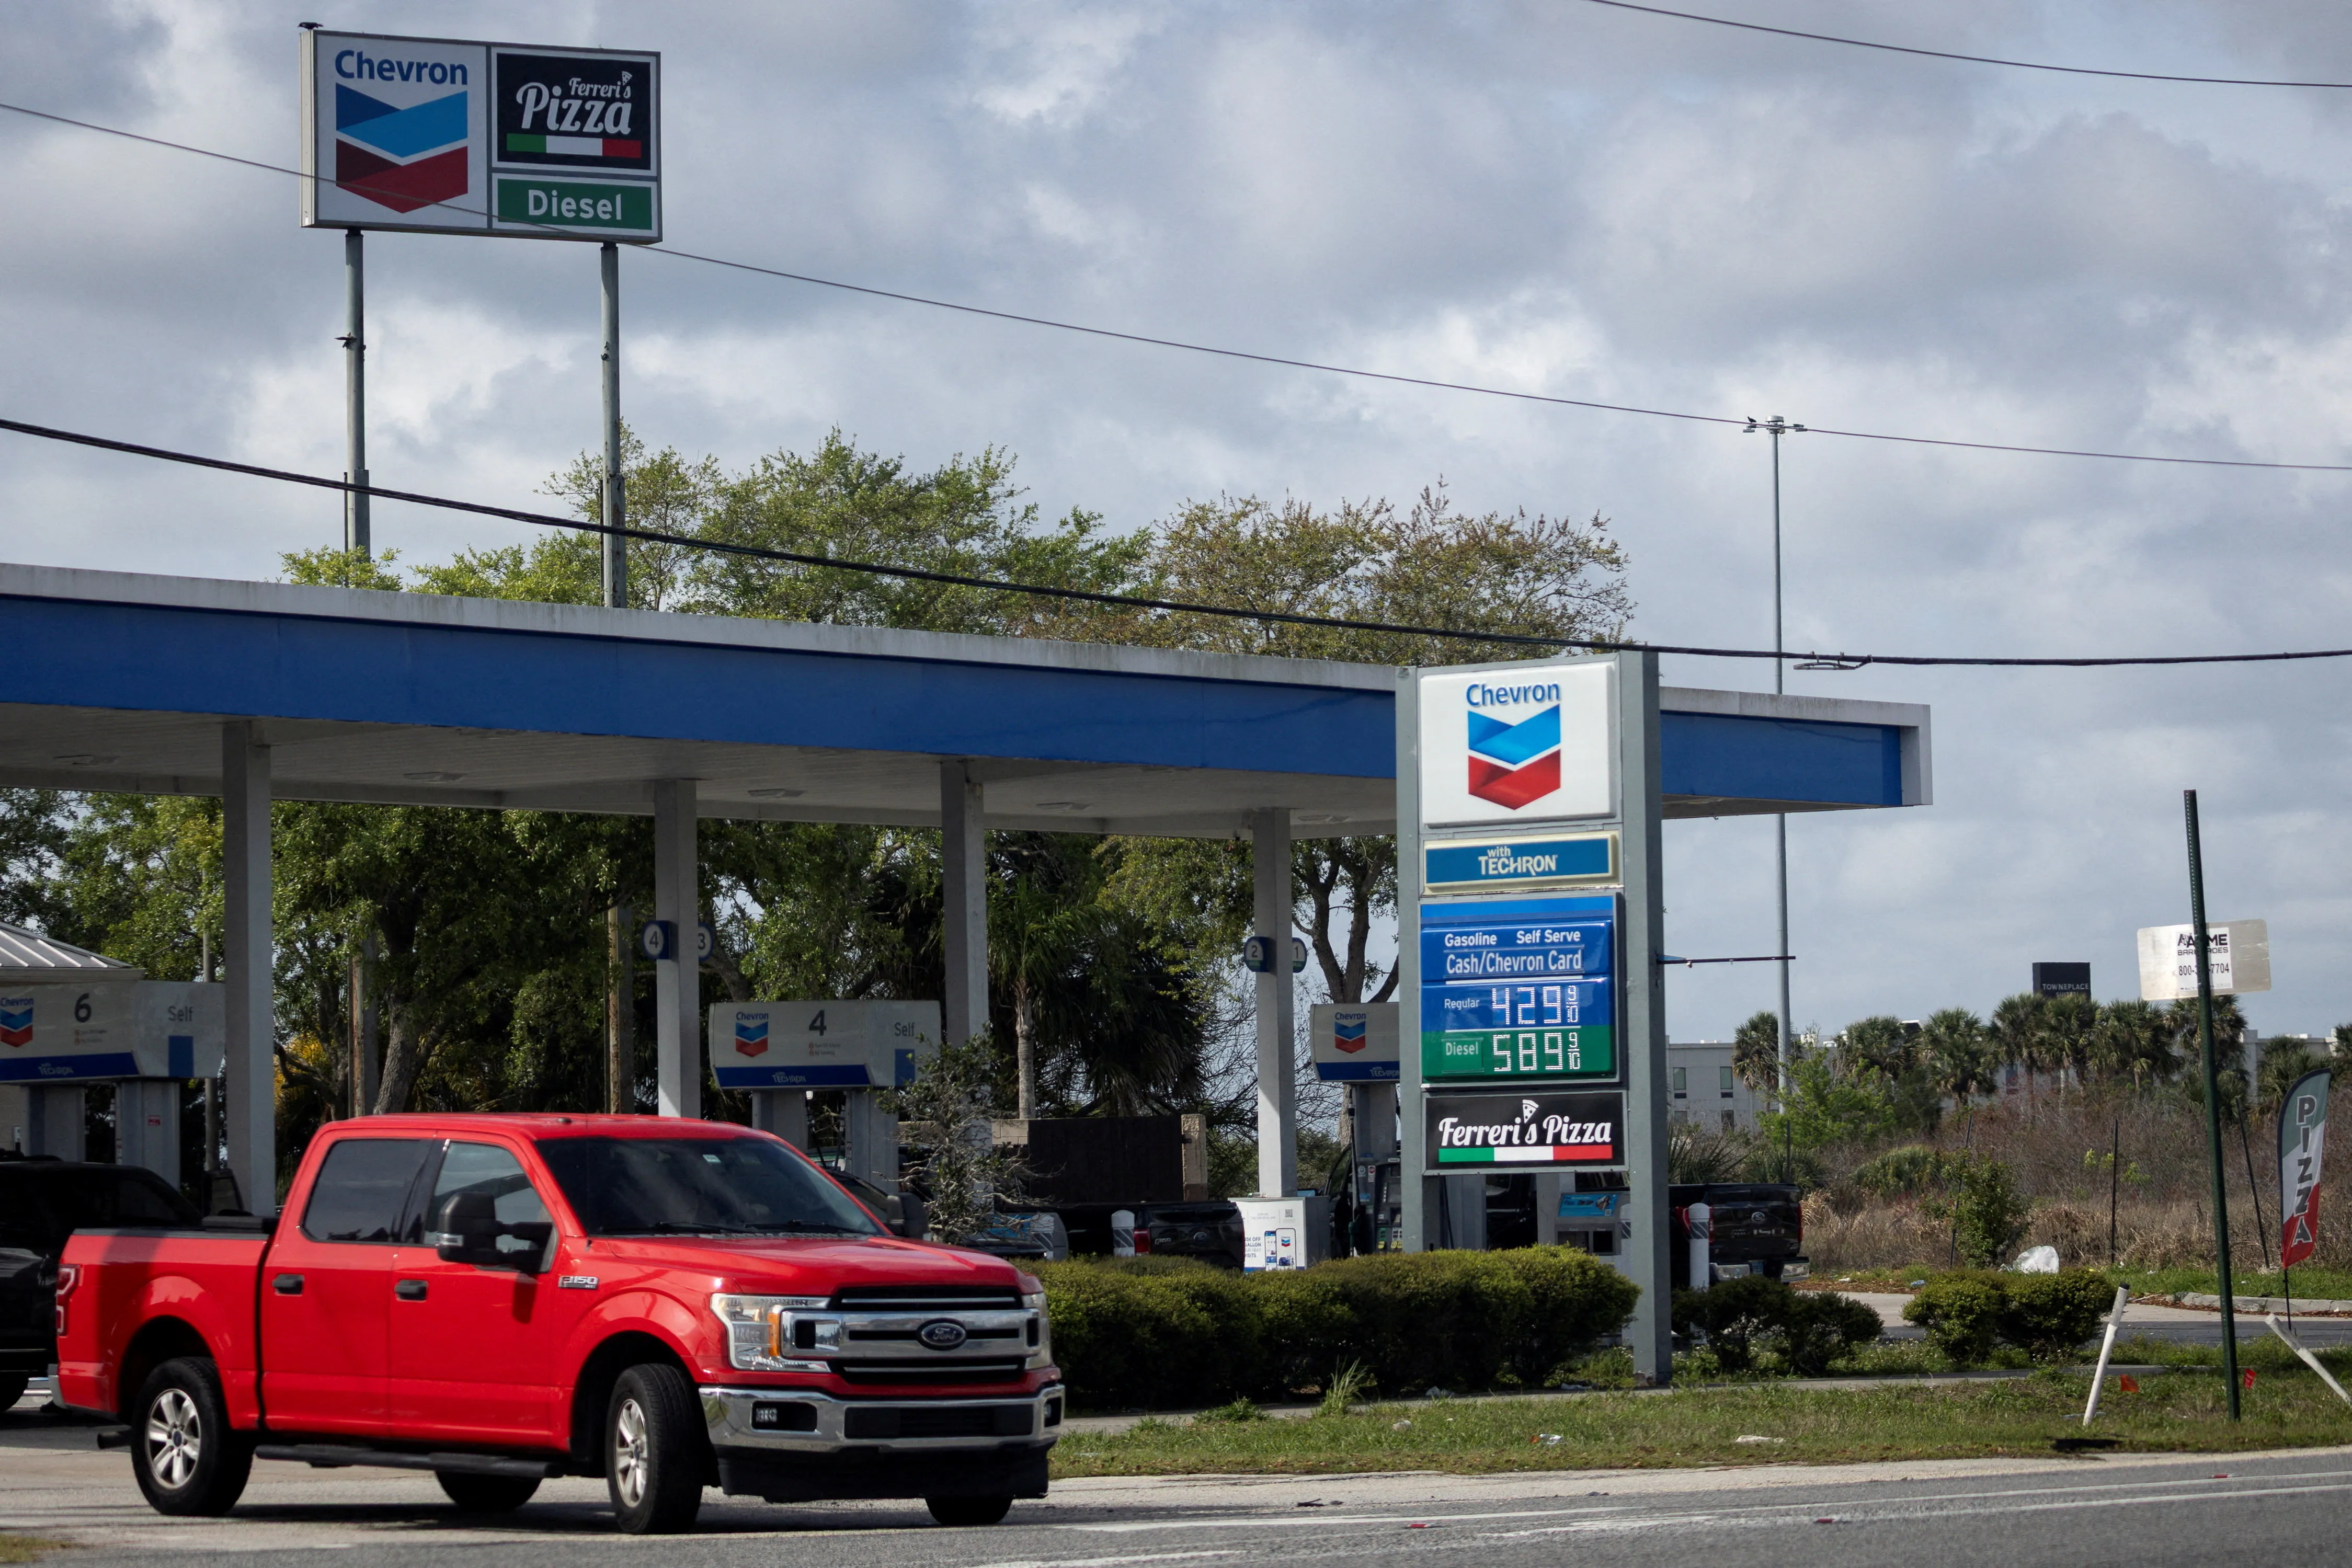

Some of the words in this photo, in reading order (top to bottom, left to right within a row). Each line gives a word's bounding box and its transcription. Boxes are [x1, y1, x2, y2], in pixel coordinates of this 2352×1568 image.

[335, 50, 467, 85] Chevron
[516, 82, 632, 134] Pizza
[529, 189, 621, 220] Diesel
[1466, 683, 1561, 706] Chevron
[1487, 846, 1511, 858] with
[1478, 854, 1557, 876] TECHRON
[649, 931, 659, 948] 4
[698, 933, 705, 949] 3
[1445, 932, 1497, 947] Gasoline
[1516, 930, 1541, 944] Self
[1544, 929, 1581, 942] Serve
[2178, 934, 2228, 947] AAME
[1251, 945, 1258, 957] 2
[1295, 946, 1298, 958] 1
[2178, 947, 2228, 955] BARADES
[1447, 951, 1544, 974] Cash/Chevron
[1548, 949, 1581, 970] Card
[2179, 963, 2229, 976] 800--7704
[1, 998, 33, 1006] Chevron
[74, 992, 92, 1023] 6
[1445, 998, 1480, 1010] Regular
[168, 1006, 193, 1022] Self
[736, 1012, 769, 1020] Chevron
[809, 1010, 826, 1036] 4
[895, 1022, 915, 1036] Self
[1445, 1042, 1479, 1056] Diesel
[772, 1074, 806, 1084] TECHRON
[1543, 1115, 1611, 1143] Pizza
[2294, 1095, 2316, 1243] PIZZA
[933, 1327, 956, 1341] Ford
